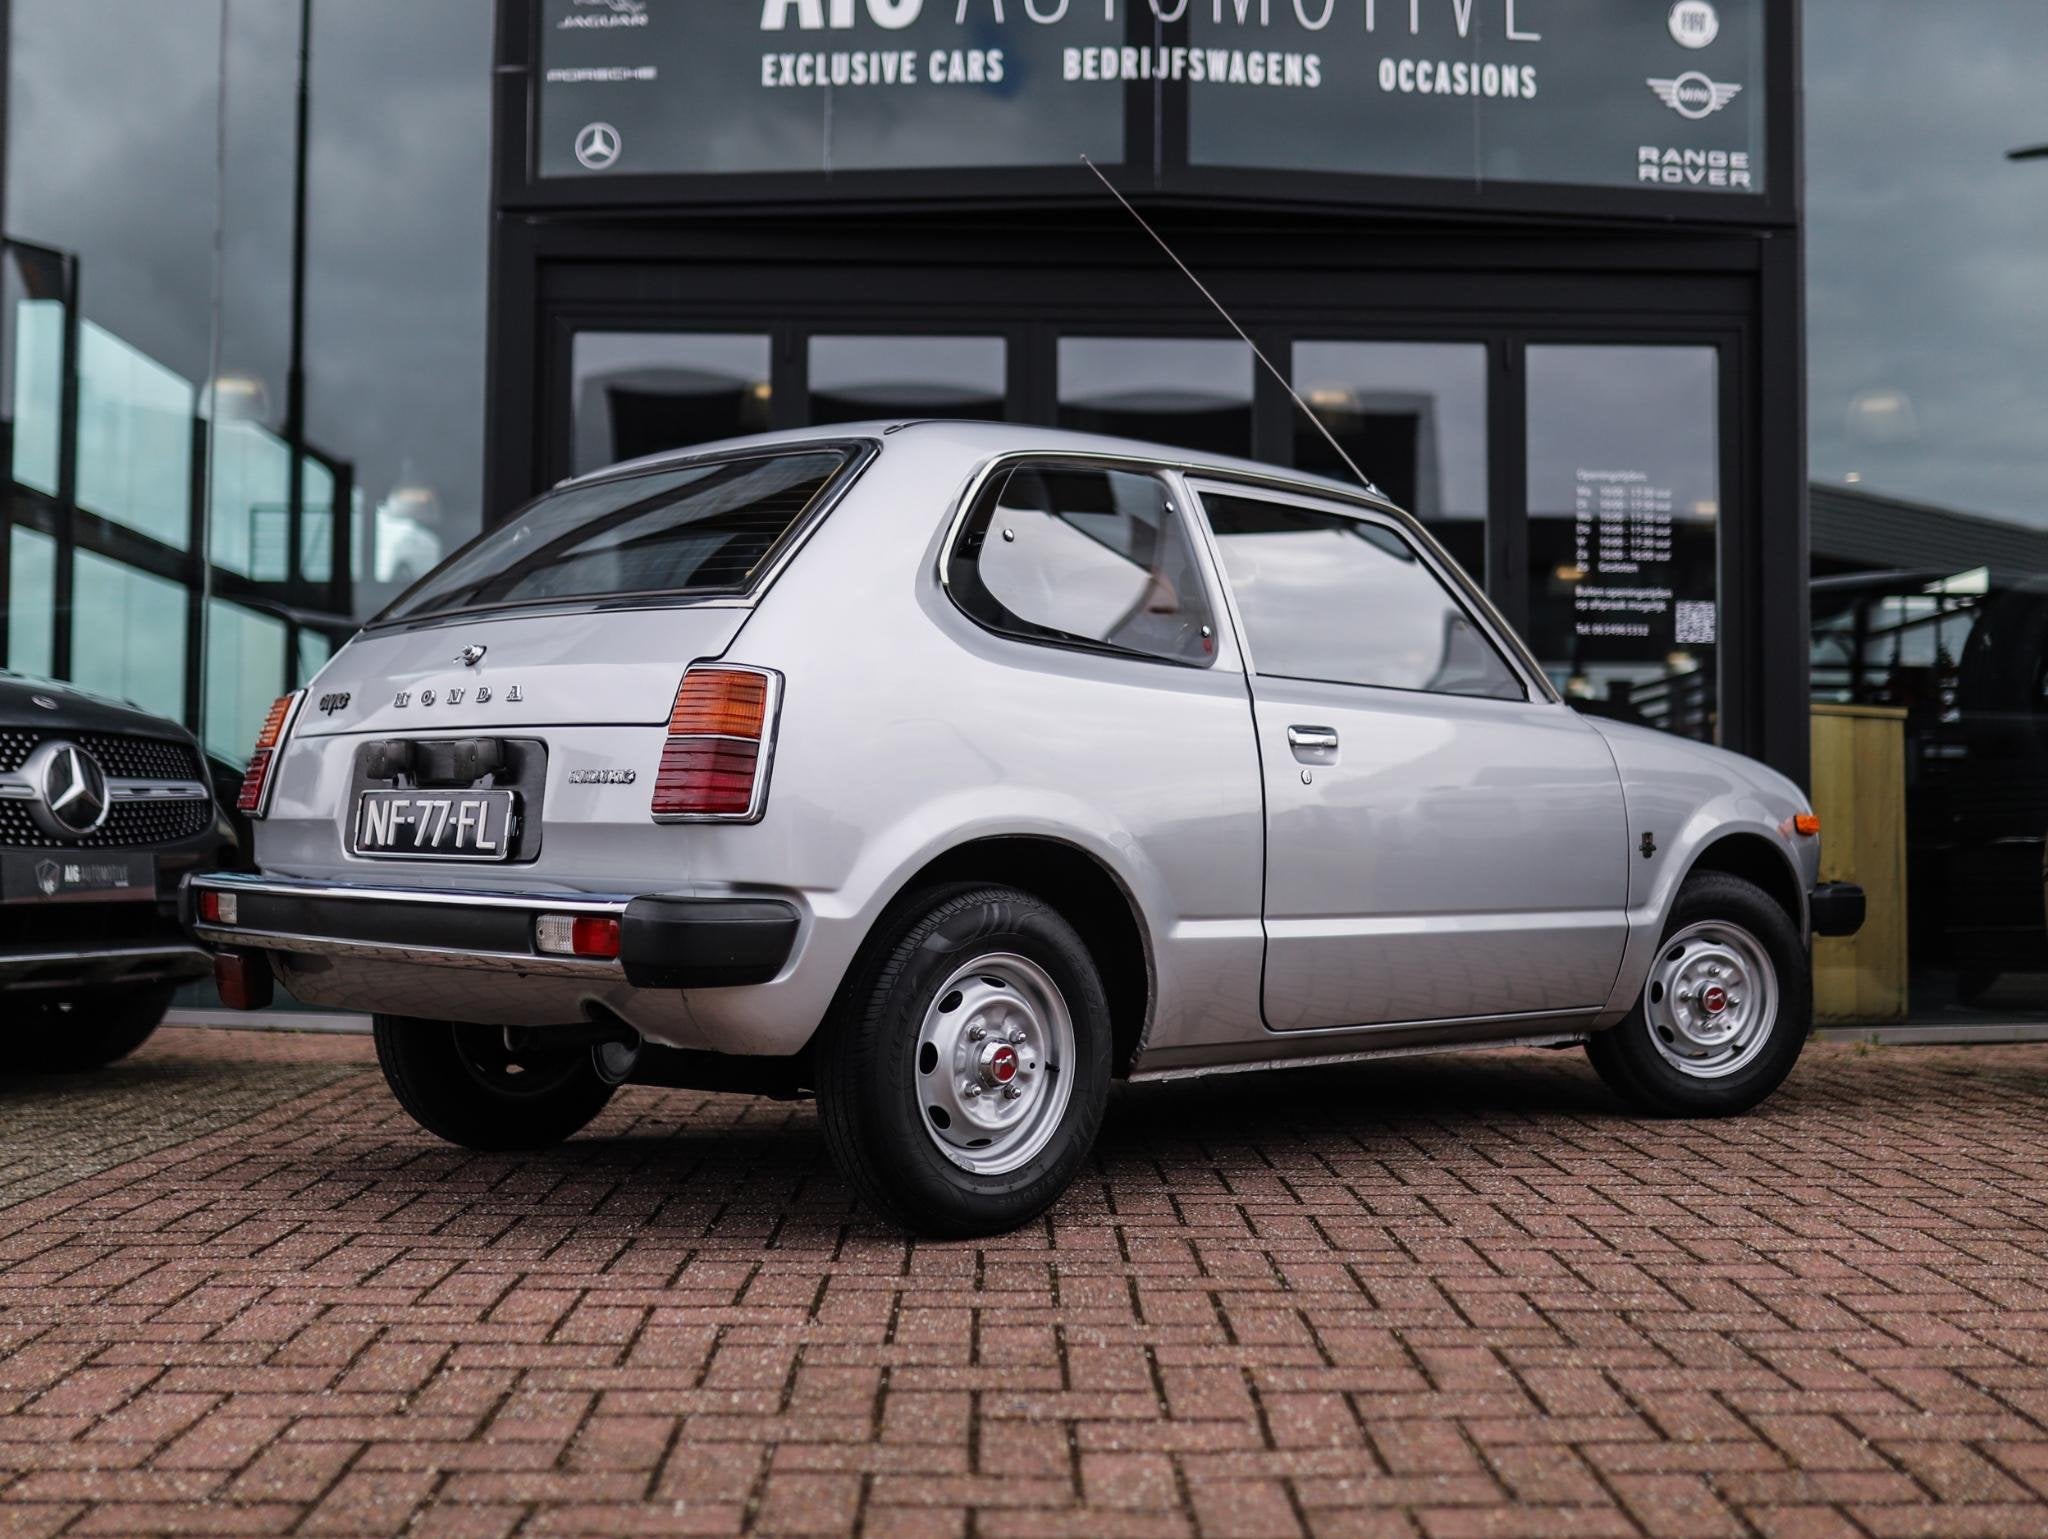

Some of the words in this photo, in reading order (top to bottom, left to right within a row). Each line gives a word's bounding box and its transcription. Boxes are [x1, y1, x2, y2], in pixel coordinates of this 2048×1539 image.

[761, 51, 917, 87] EXCLUSIVE
[928, 48, 1004, 83] CARS
[1062, 46, 1321, 88] BEDRIJFSWAGENS
[1378, 57, 1537, 99] OCCASIONS
[1638, 145, 1749, 169] RANGE
[1638, 164, 1750, 187] ROVER
[393, 685, 522, 708] HONDA
[364, 800, 496, 849] NF-77-FL
